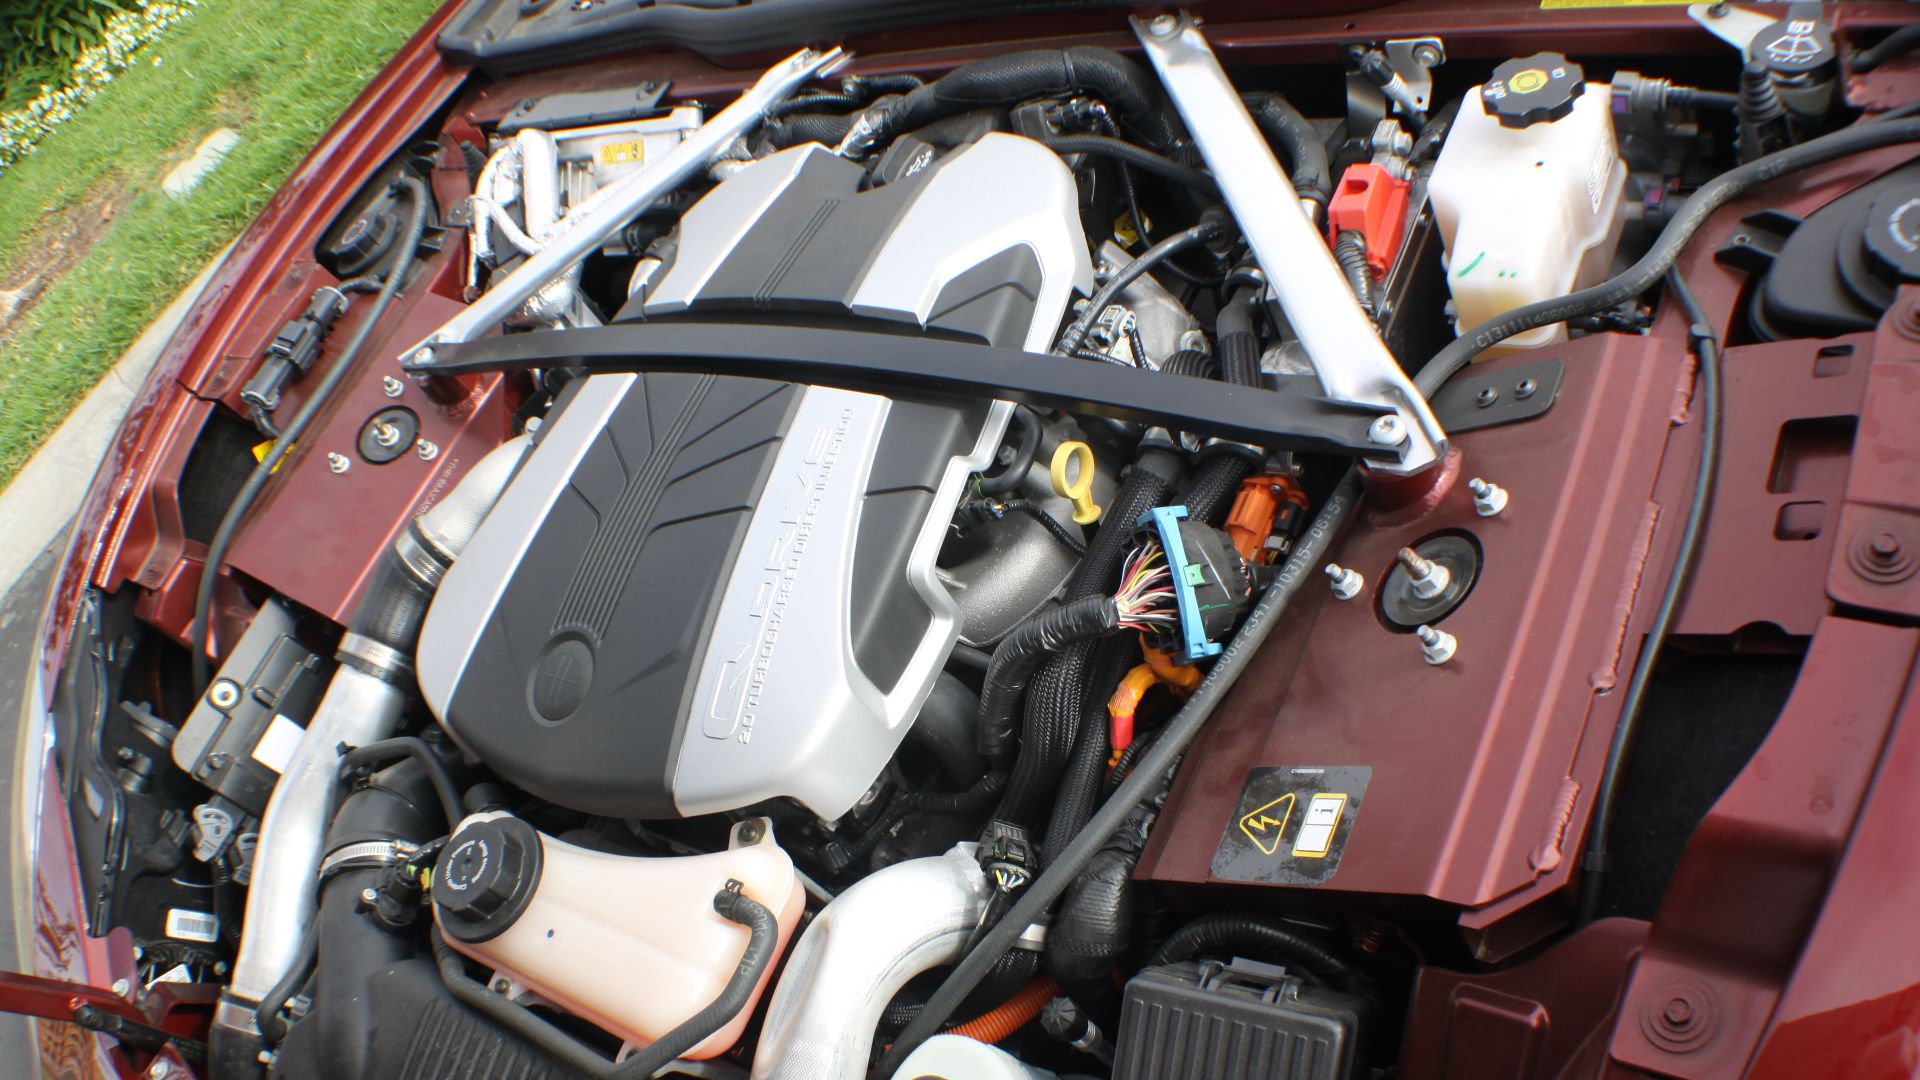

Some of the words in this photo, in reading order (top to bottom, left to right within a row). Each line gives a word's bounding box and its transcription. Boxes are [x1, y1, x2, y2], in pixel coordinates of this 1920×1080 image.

[745, 557, 800, 711] TURBOCHARGED
[792, 494, 821, 555] DIRECT
[814, 407, 855, 490] INJECTION
